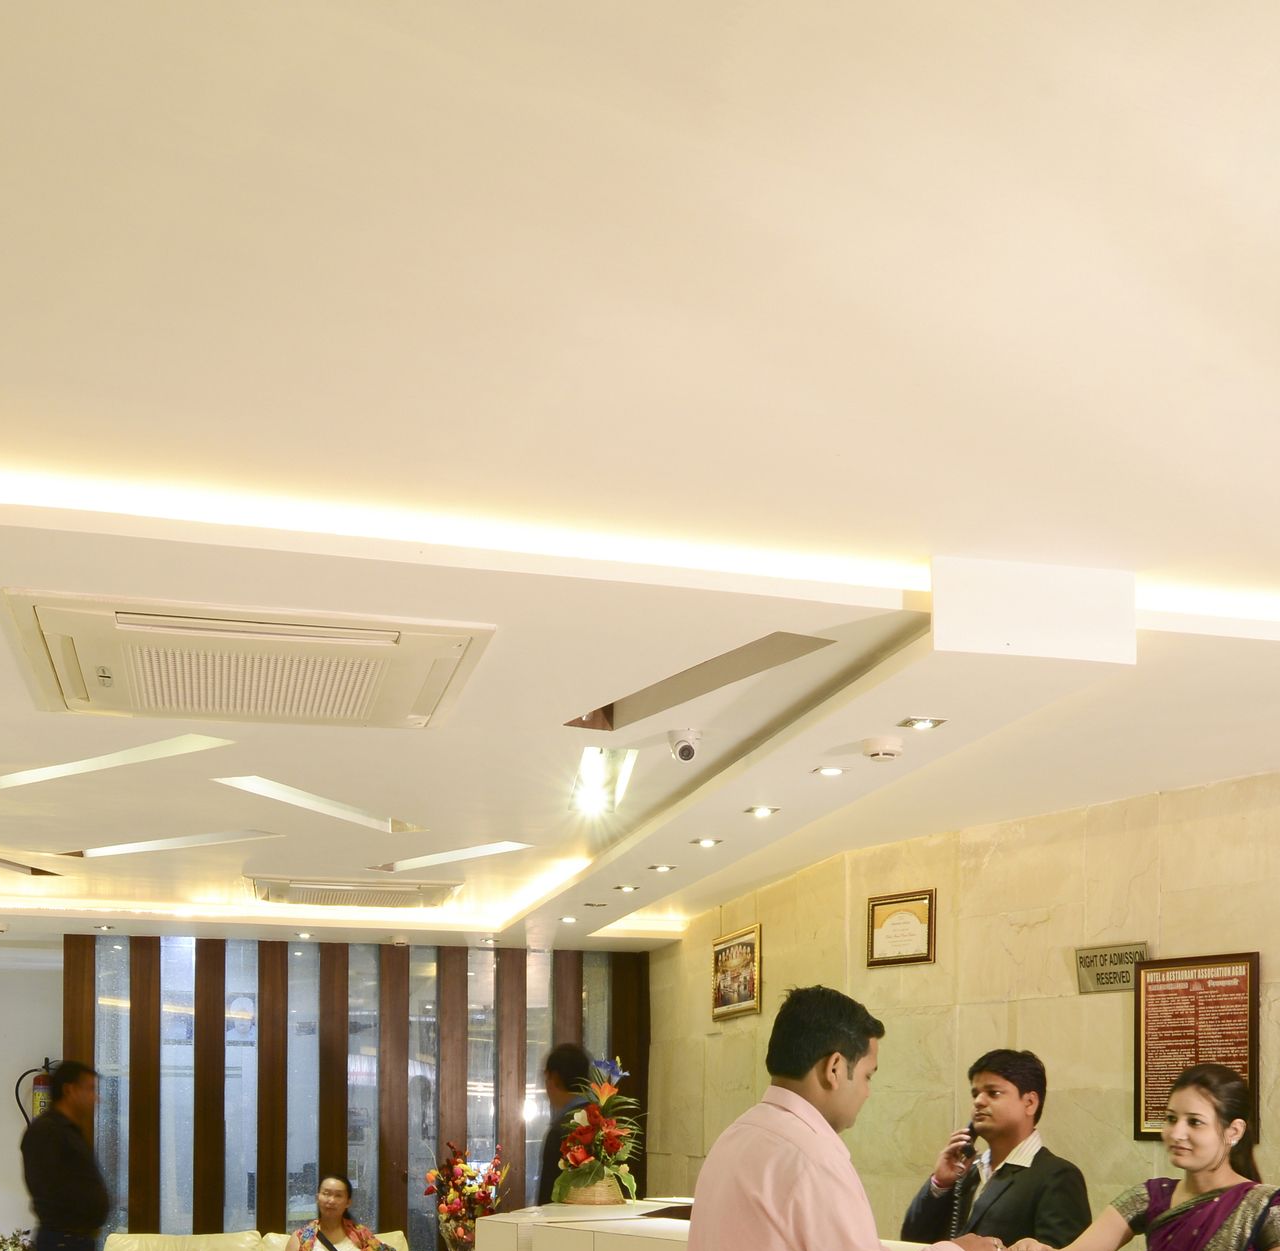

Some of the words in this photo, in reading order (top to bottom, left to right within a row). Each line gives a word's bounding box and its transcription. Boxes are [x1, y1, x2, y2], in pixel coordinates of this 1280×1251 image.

[1079, 954, 1098, 969] RIGHT
[1100, 953, 1108, 967] OF
[1110, 950, 1145, 966] ADMISSION
[1096, 970, 1131, 986] RESERVED
[1146, 972, 1161, 983] HOTEL
[1166, 969, 1197, 981] RESTAURANT
[1197, 966, 1232, 979] ASSOCIATION
[1232, 965, 1246, 976] AGRA
